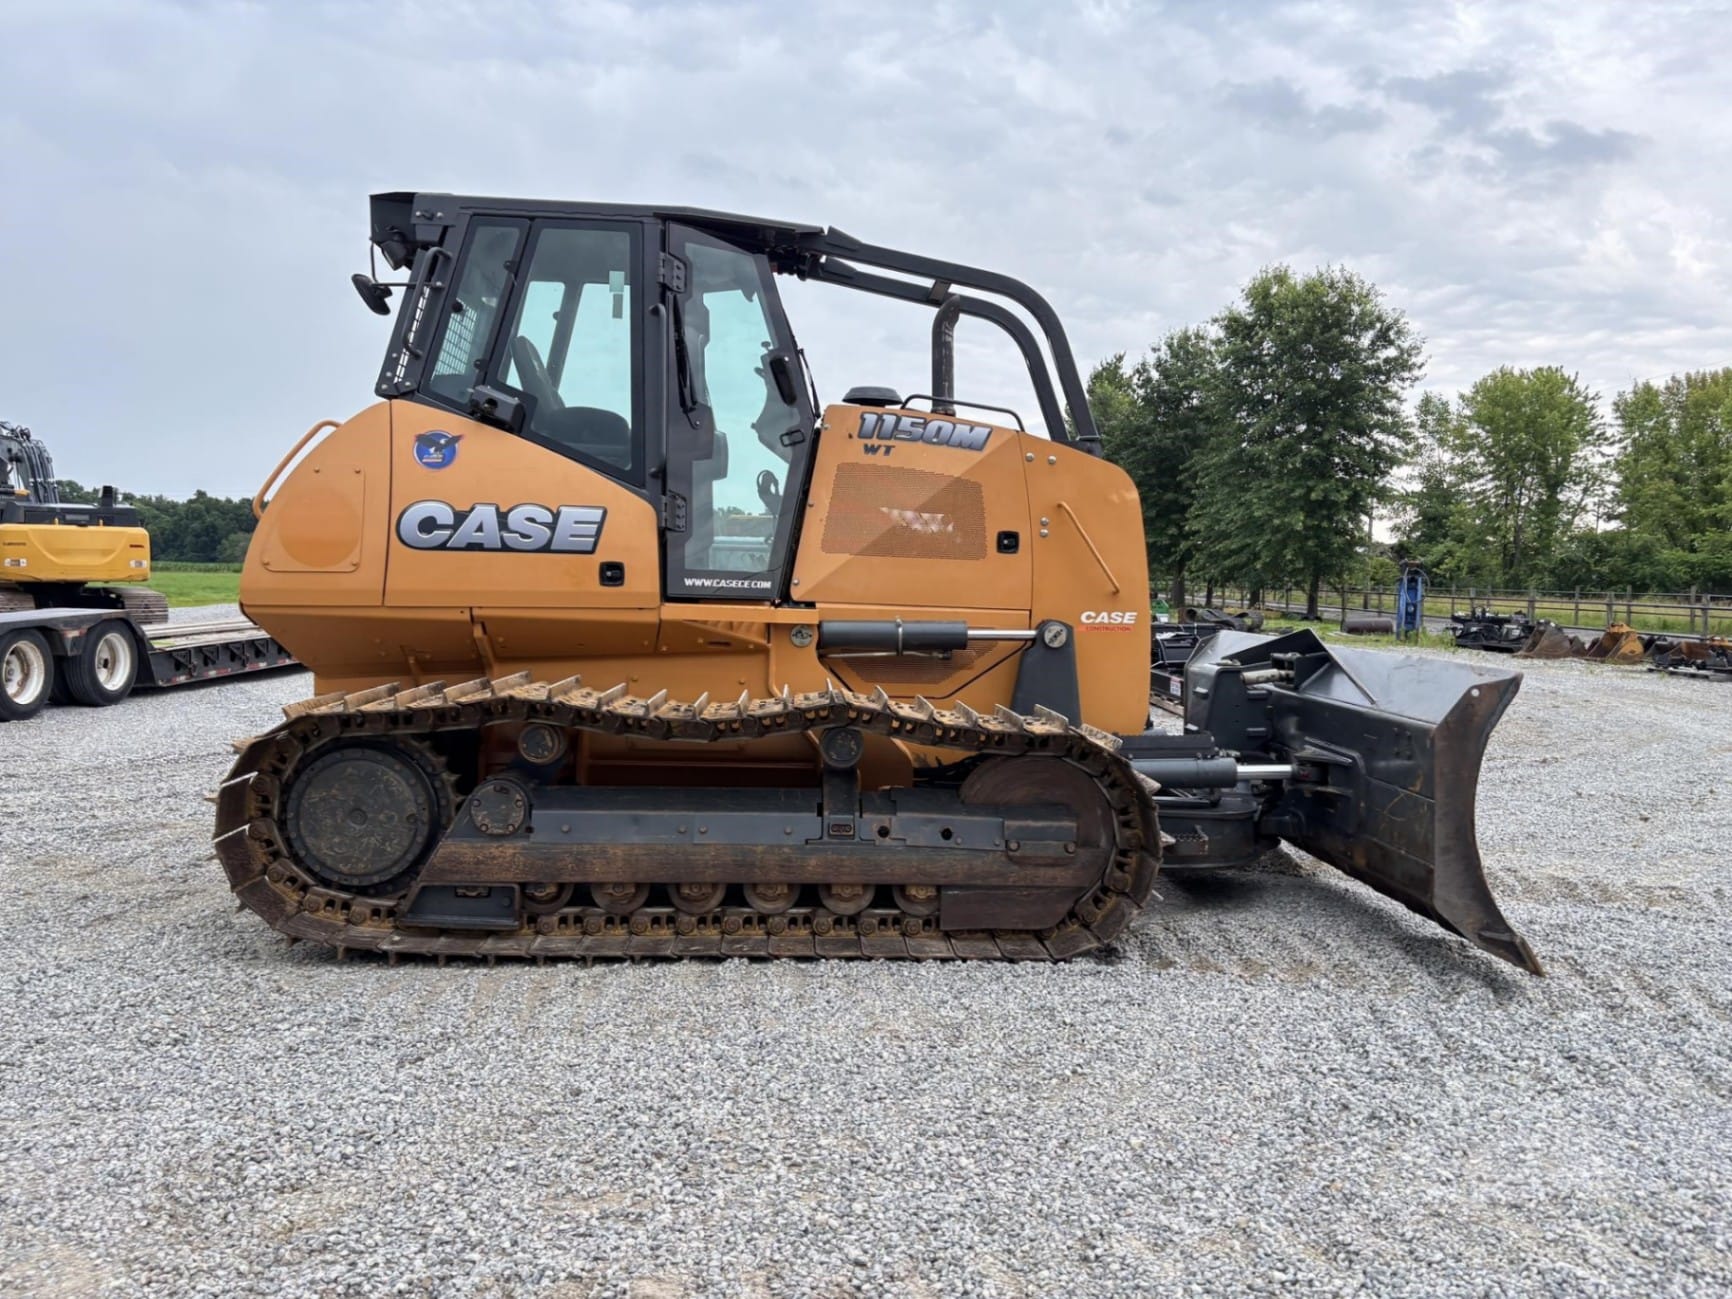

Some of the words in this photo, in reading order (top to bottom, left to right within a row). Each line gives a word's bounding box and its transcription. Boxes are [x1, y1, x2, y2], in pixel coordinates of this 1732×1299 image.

[858, 412, 992, 451] 1150M
[863, 443, 896, 456] WT
[397, 499, 606, 552] CASE
[1080, 611, 1138, 624] CASE
